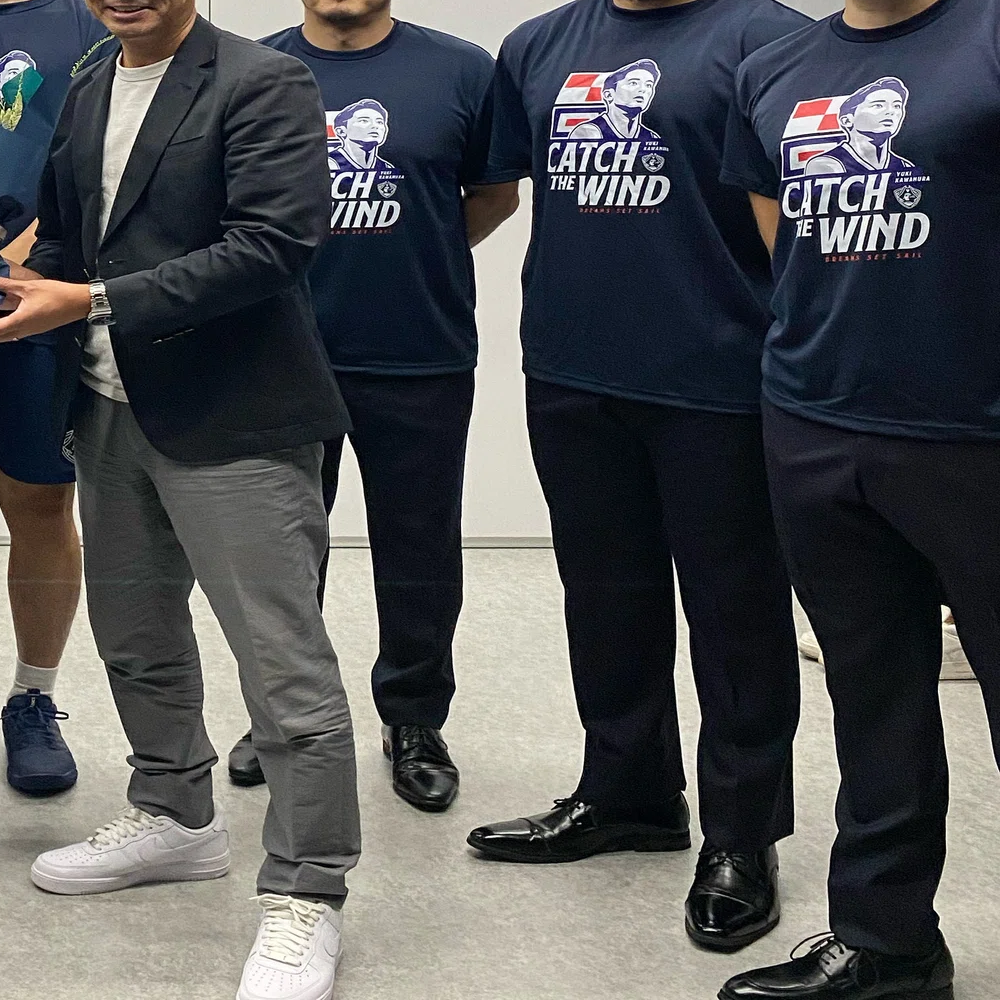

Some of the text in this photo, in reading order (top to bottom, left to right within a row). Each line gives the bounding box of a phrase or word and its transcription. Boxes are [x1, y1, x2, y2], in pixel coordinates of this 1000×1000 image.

[547, 141, 641, 173] CATCH
[550, 175, 671, 207] THE WIND
[782, 172, 892, 219] CATCH
[818, 212, 931, 254] WIND
